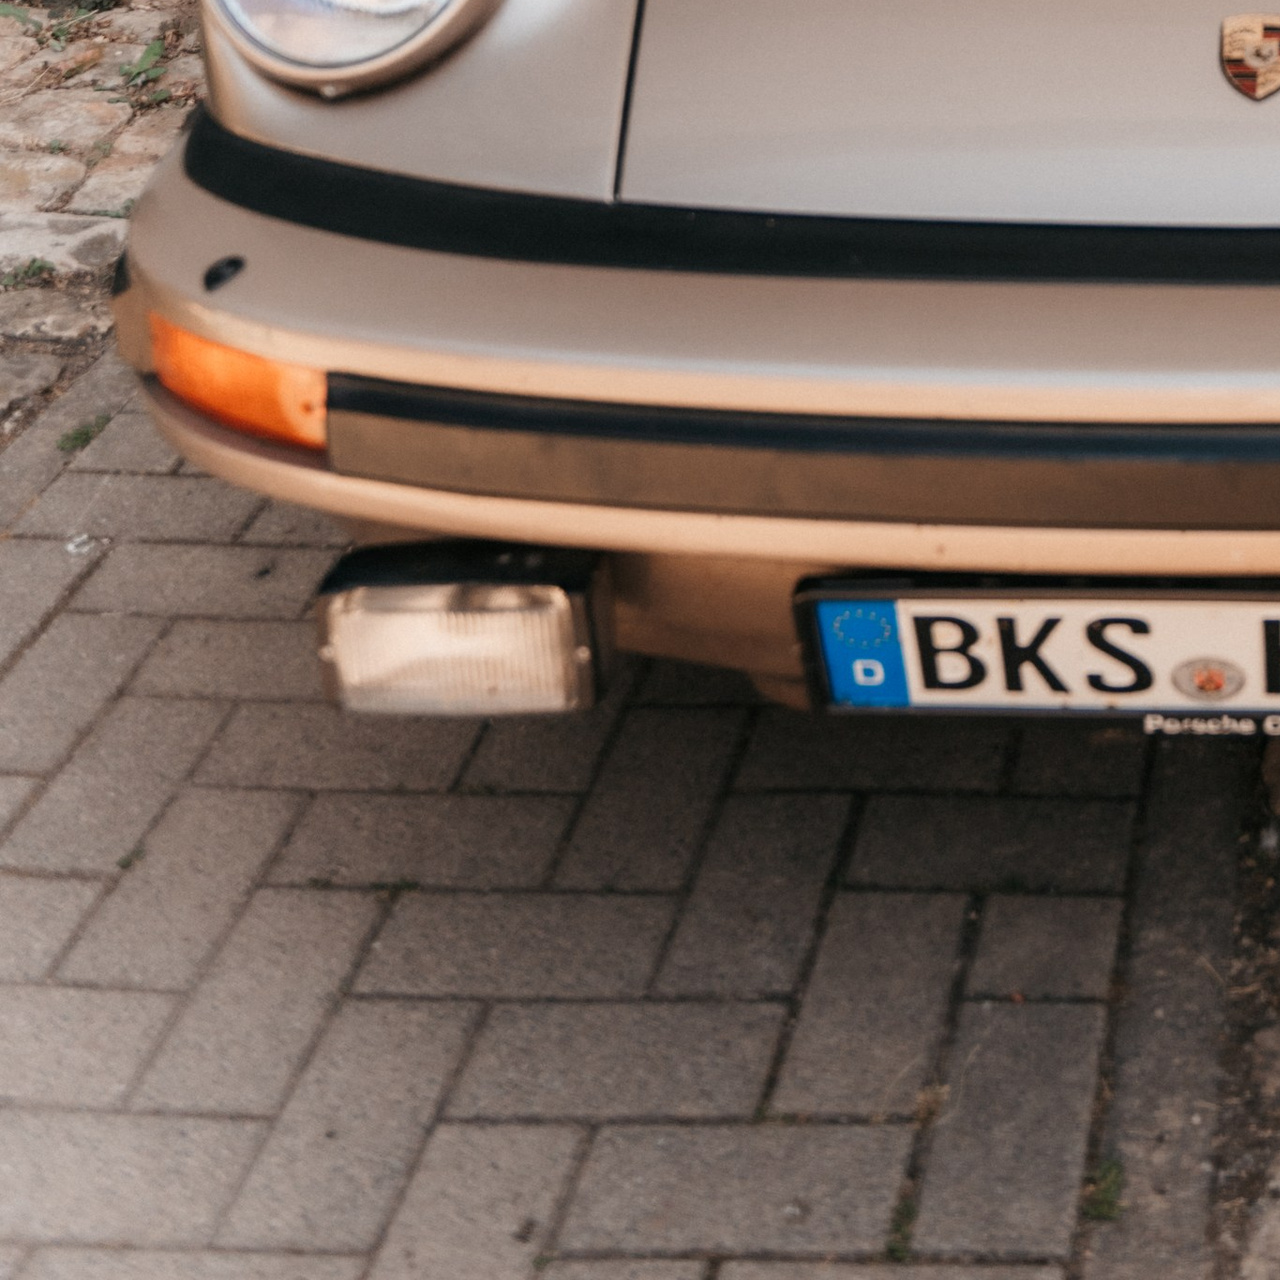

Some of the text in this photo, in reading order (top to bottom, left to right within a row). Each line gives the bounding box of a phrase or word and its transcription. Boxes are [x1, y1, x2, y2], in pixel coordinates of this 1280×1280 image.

[912, 615, 1155, 694] BKS
[851, 658, 886, 687] D
[1142, 712, 1257, 736] Porsche
